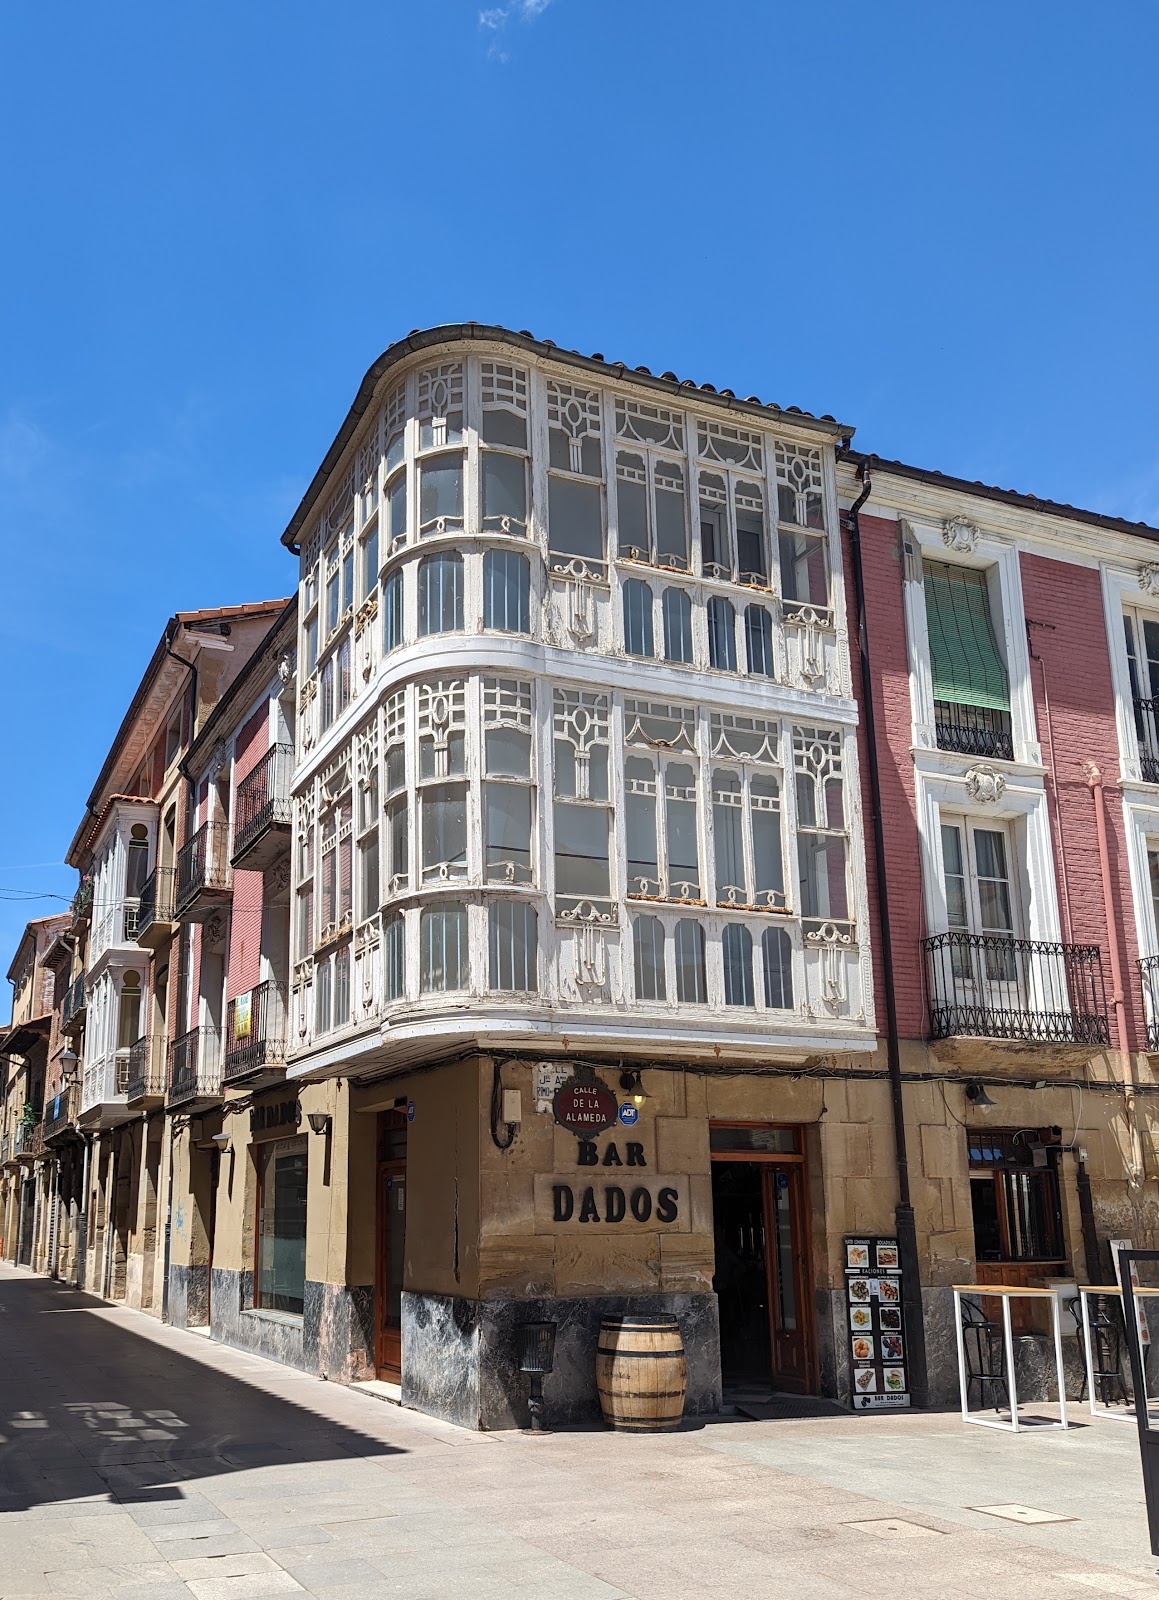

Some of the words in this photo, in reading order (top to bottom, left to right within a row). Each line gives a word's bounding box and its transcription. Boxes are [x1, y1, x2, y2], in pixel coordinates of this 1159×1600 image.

[573, 1087, 598, 1095] CALLE
[573, 1098, 584, 1108] DE
[588, 1099, 600, 1109] LA
[565, 1112, 607, 1123] ALAMEDA
[621, 1108, 636, 1117] ADT
[577, 1141, 647, 1167] BAR
[552, 1185, 679, 1223] DADOS
